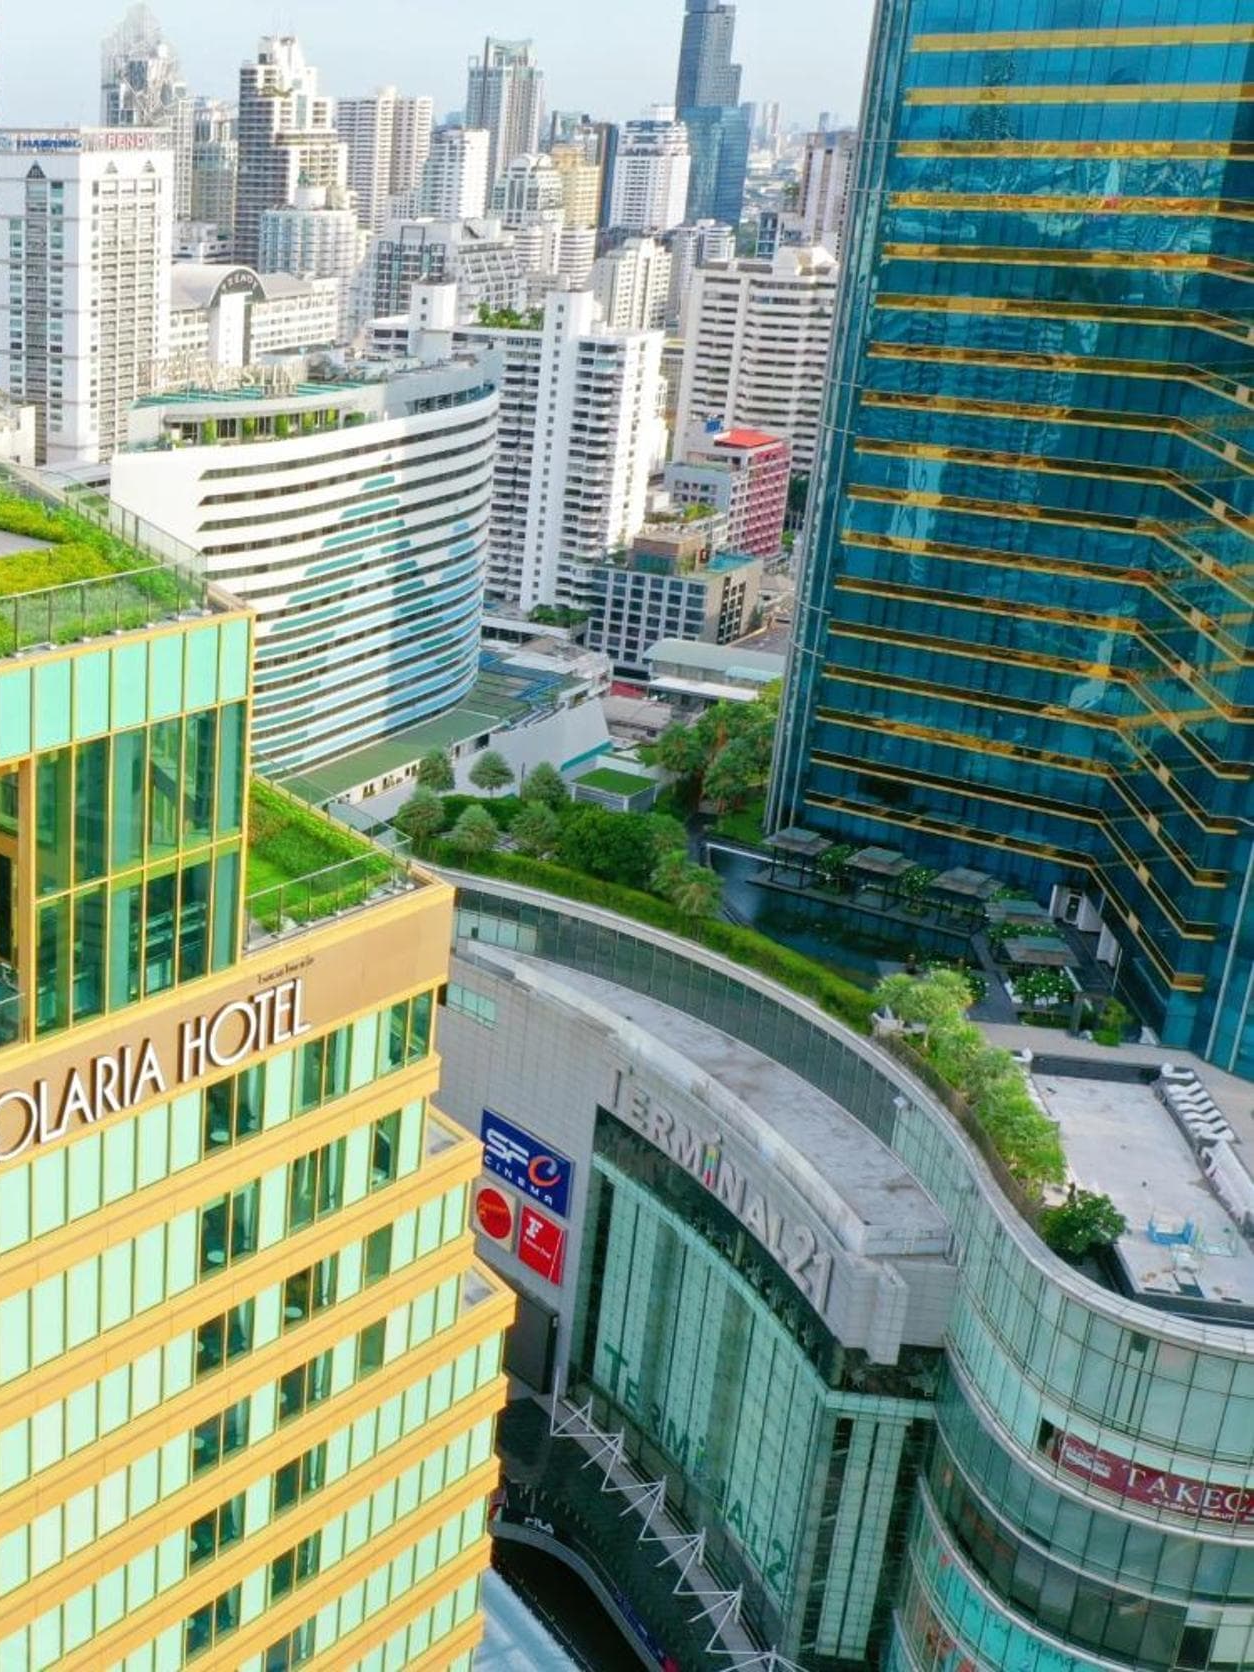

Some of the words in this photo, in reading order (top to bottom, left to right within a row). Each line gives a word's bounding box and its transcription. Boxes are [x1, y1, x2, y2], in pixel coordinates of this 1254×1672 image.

[182, 976, 312, 1084] HOTEL
[484, 1155, 554, 1207] CINEMA
[1122, 1464, 1254, 1514] TAKEC
[524, 1516, 555, 1536] FILA
